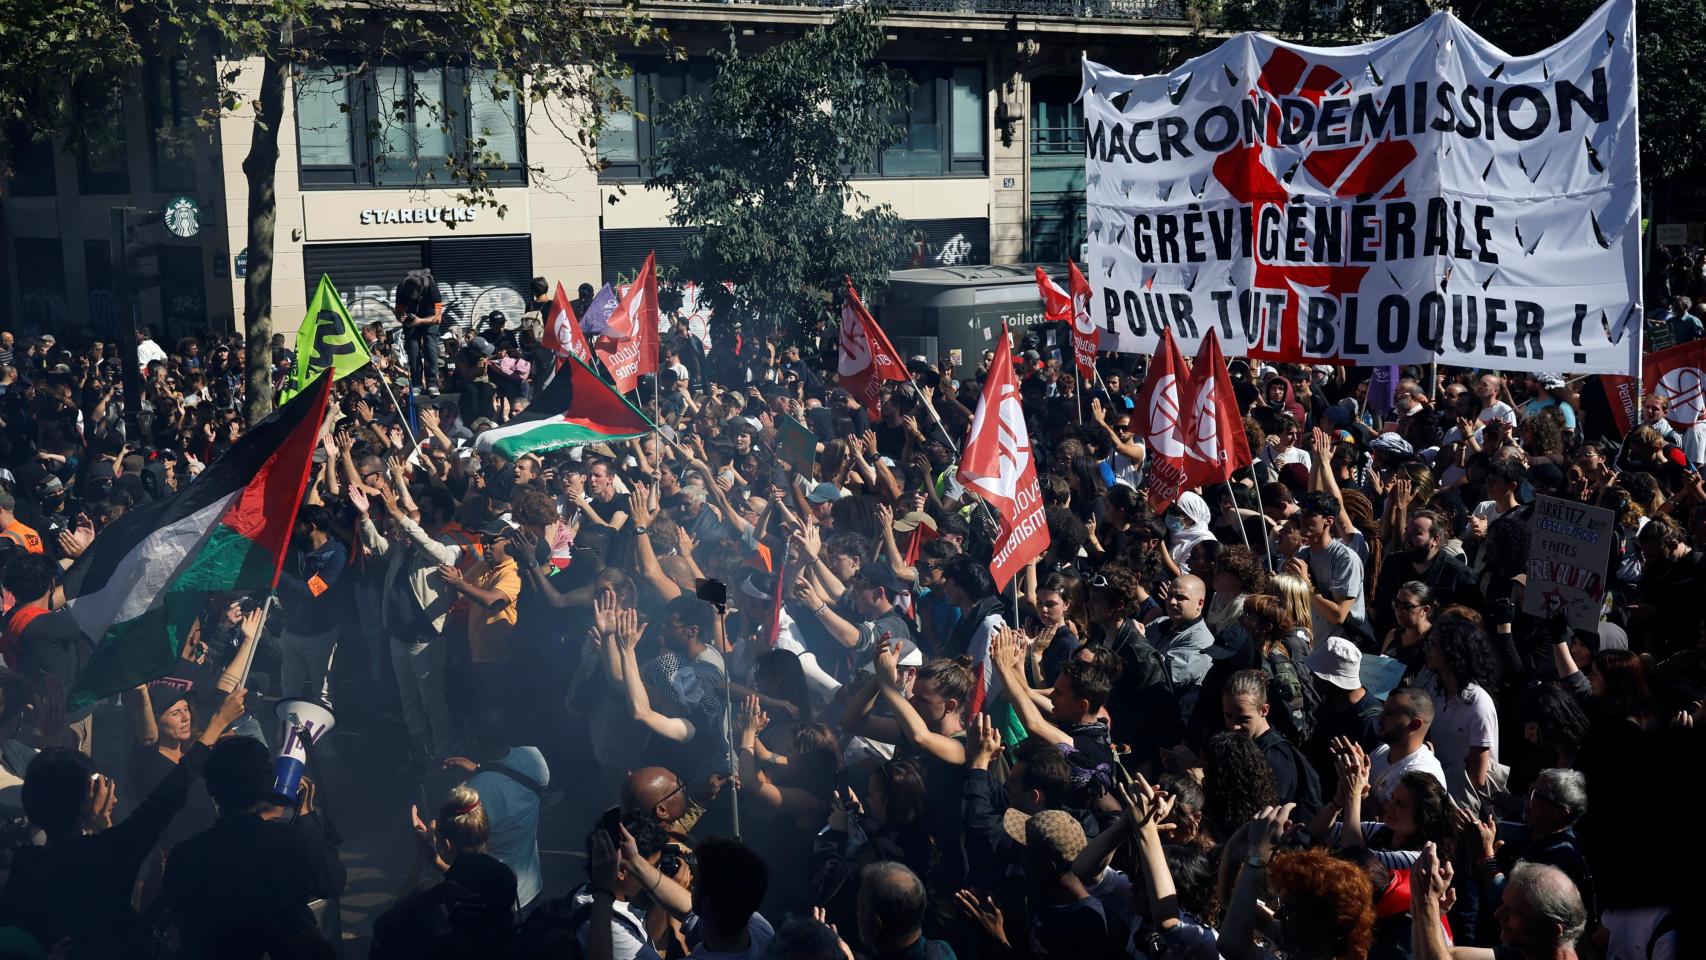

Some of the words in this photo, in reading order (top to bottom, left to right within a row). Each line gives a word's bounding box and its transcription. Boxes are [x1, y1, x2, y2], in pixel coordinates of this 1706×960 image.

[1085, 98, 1267, 164] MACRON
[1260, 193, 1499, 264] GÉNÉRALE
[1001, 313, 1058, 327] Toilett
[1103, 287, 1200, 339] POUR
[1305, 290, 1545, 360] BLOQUER
[1571, 303, 1588, 364] !
